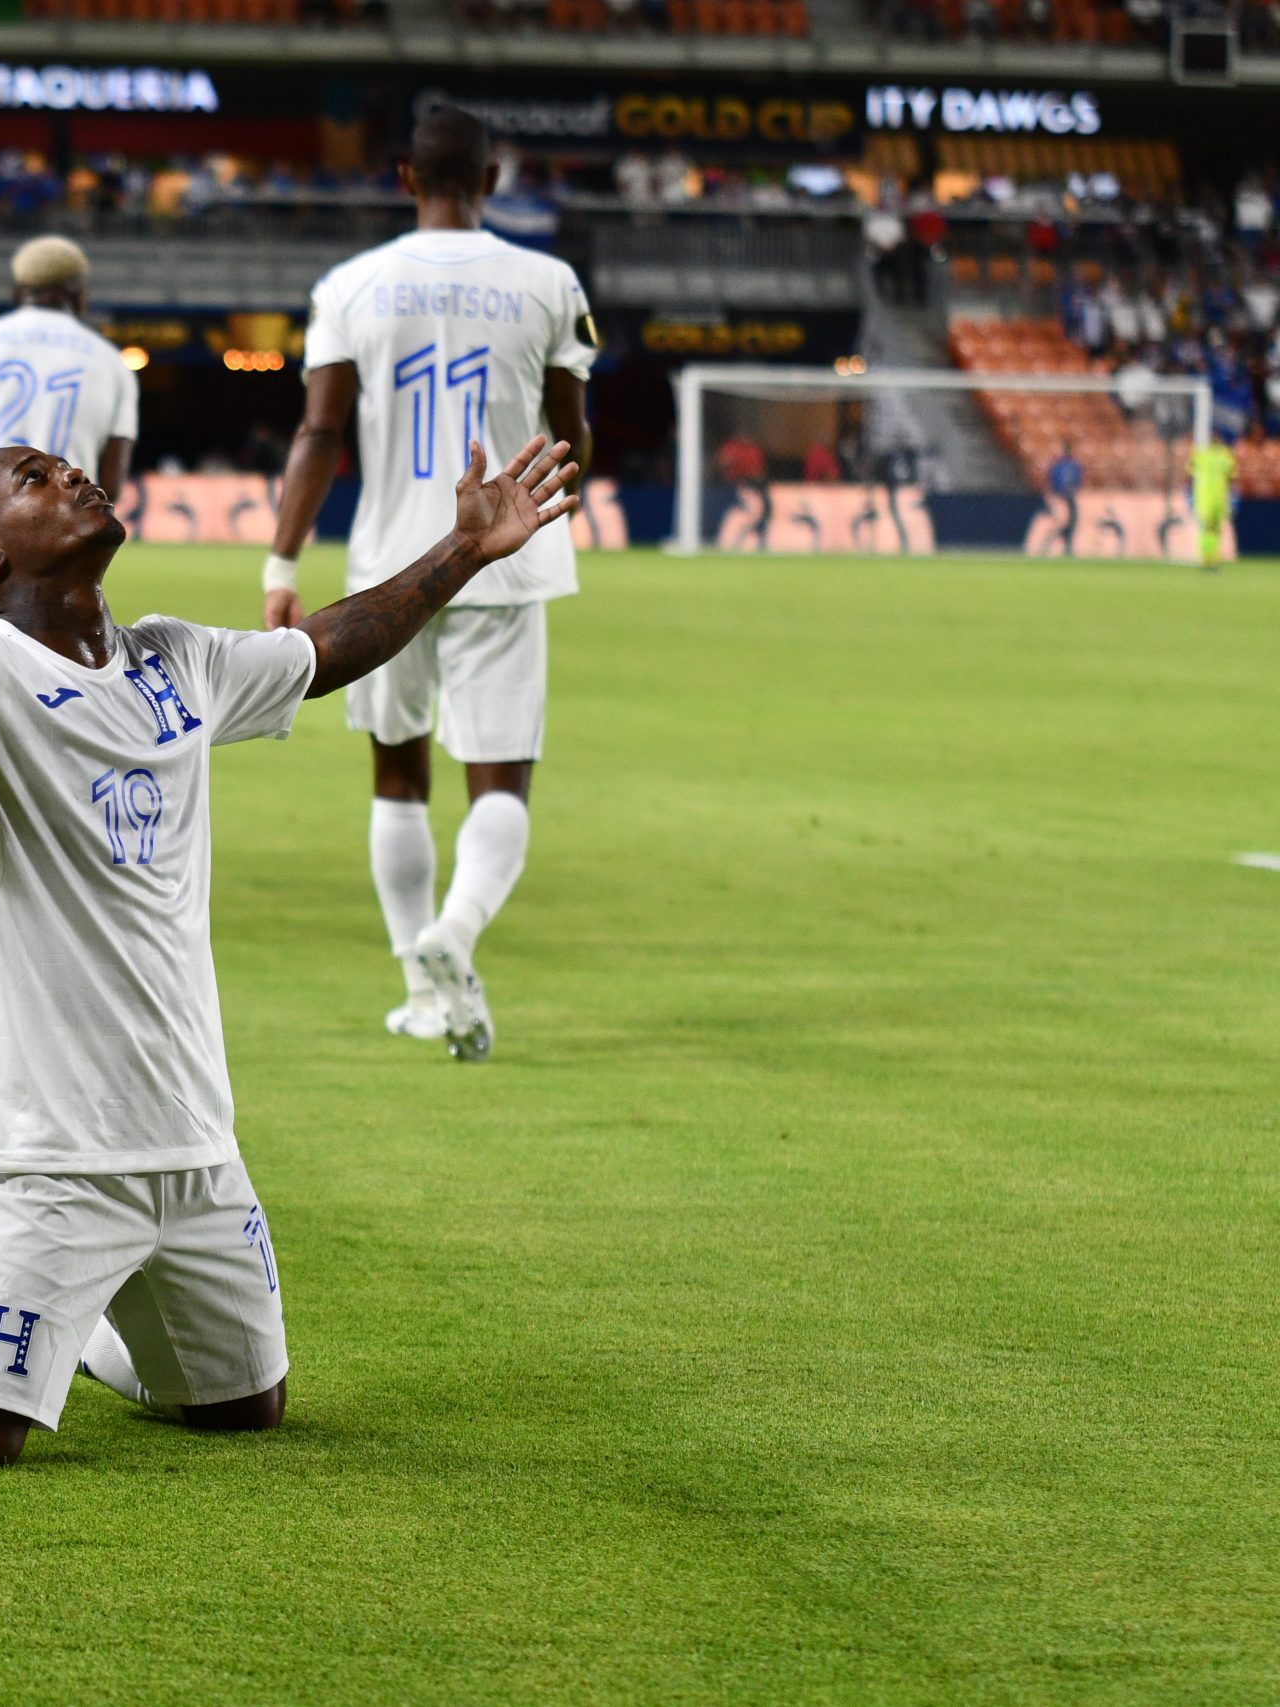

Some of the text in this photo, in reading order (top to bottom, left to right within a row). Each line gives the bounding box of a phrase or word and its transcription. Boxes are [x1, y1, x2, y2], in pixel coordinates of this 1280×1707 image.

[619, 94, 751, 139] GOLD
[757, 96, 855, 142] CUP
[942, 87, 1101, 134] DAWGS
[374, 284, 523, 323] BENGTSON
[394, 342, 490, 479] 11
[133, 677, 169, 733] HONDURAS
[91, 767, 163, 865] 19
